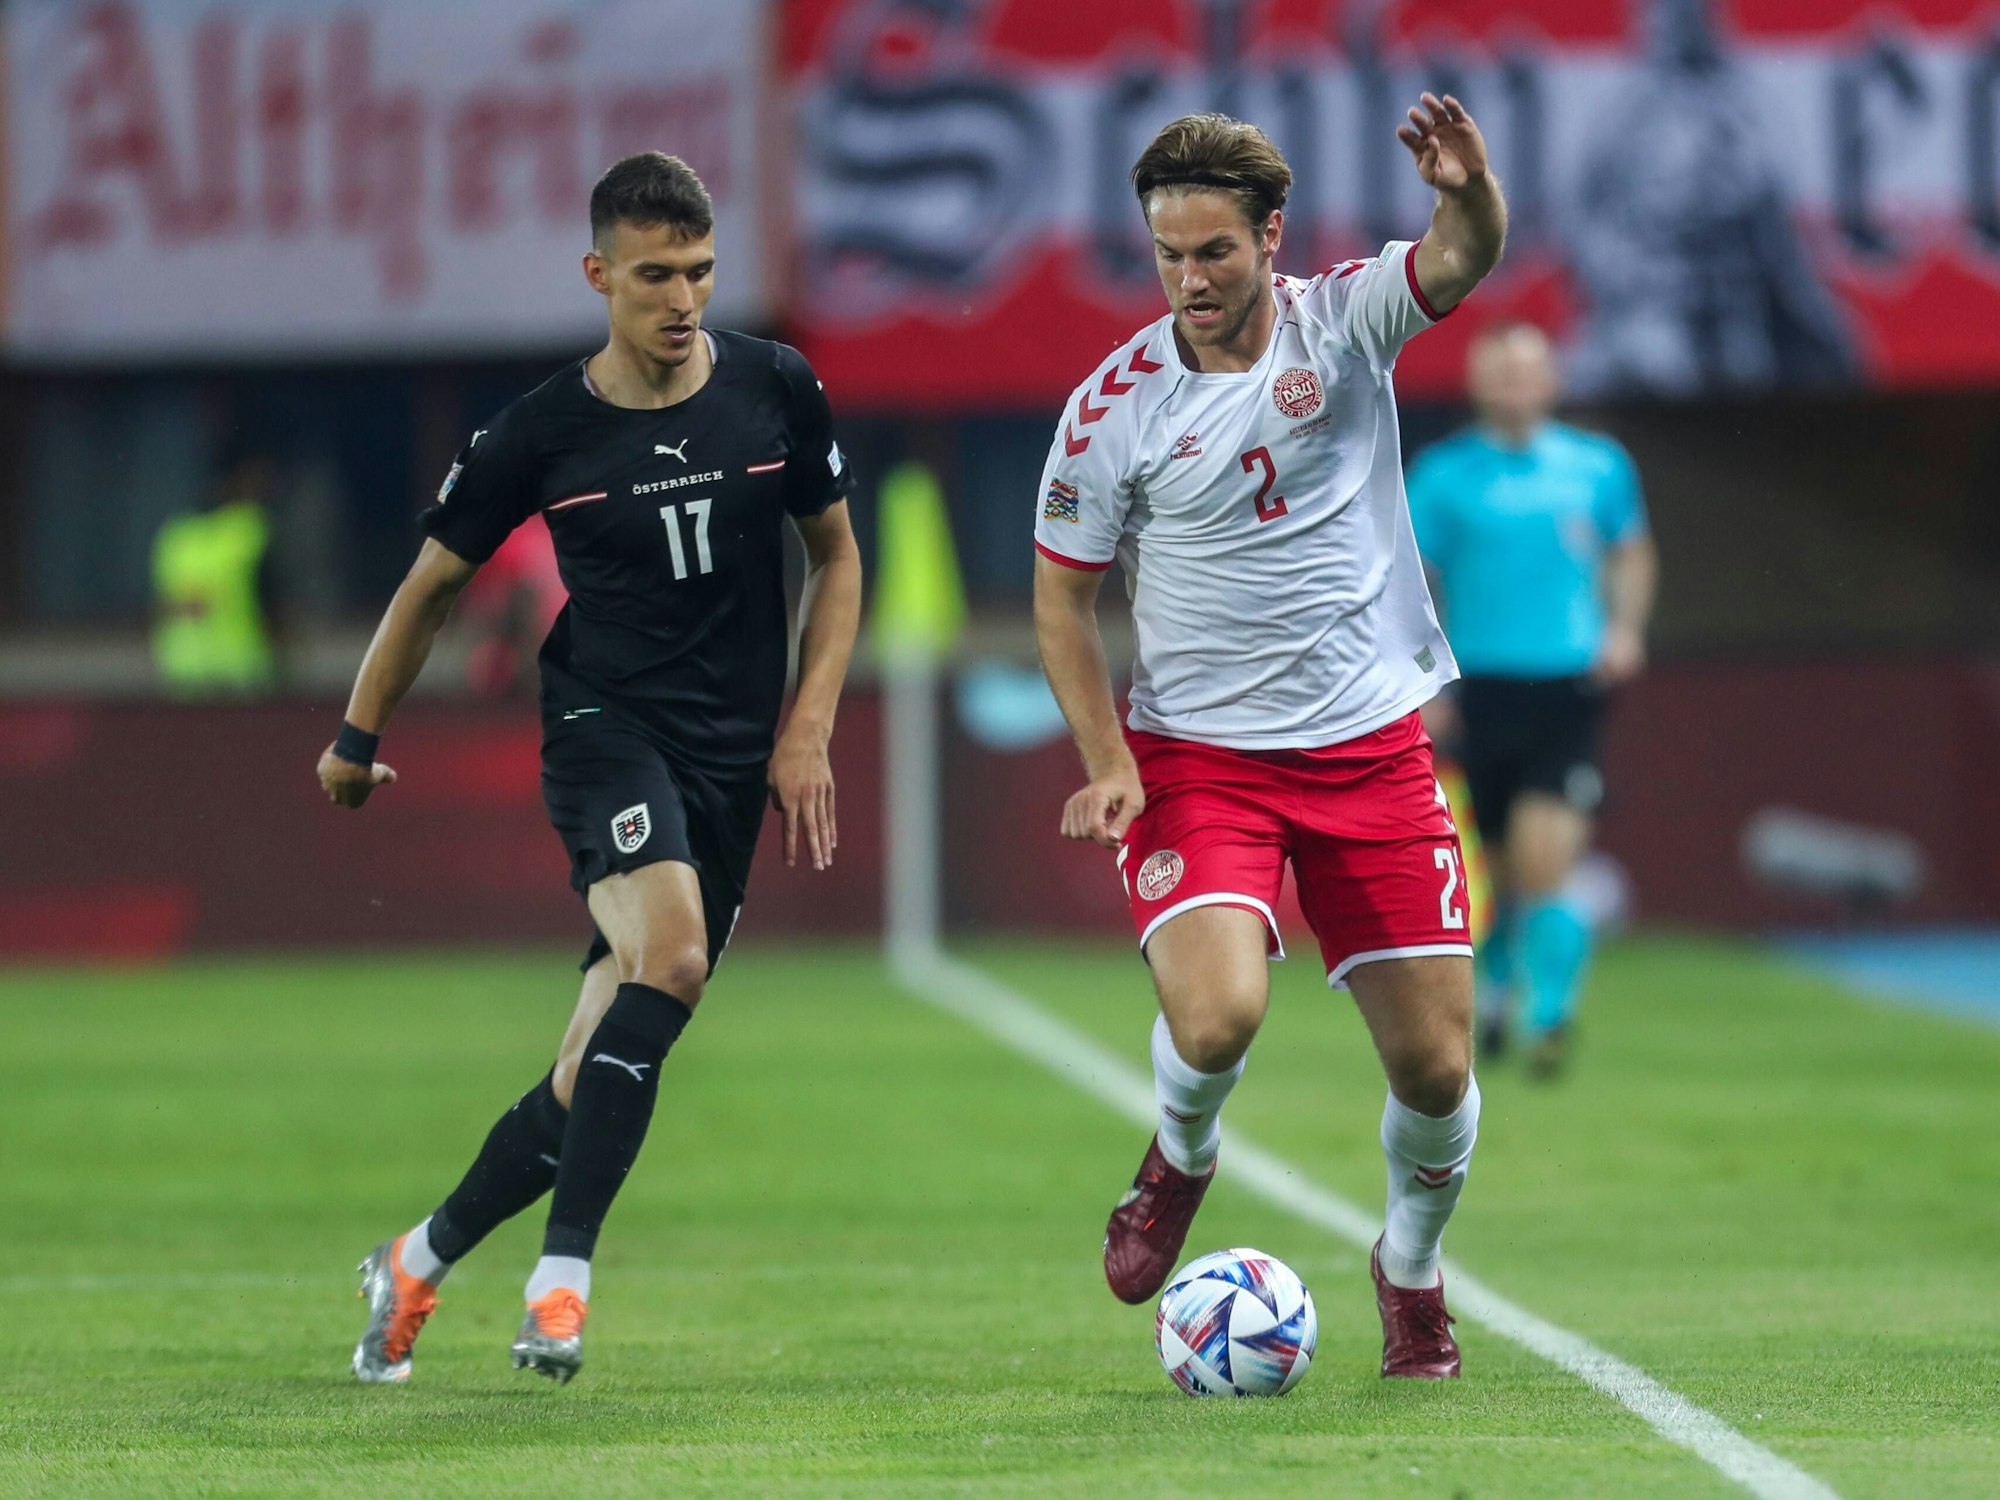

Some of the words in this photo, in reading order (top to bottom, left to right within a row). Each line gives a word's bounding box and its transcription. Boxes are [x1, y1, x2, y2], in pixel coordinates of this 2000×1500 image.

[1282, 380, 1315, 405] DBU
[1170, 447, 1202, 461] hummel
[632, 470, 724, 496] ÖSTERREICH
[1240, 446, 1289, 523] 2
[659, 498, 713, 581] 17
[1147, 862, 1173, 888] DBU
[1433, 847, 1465, 930] 2
